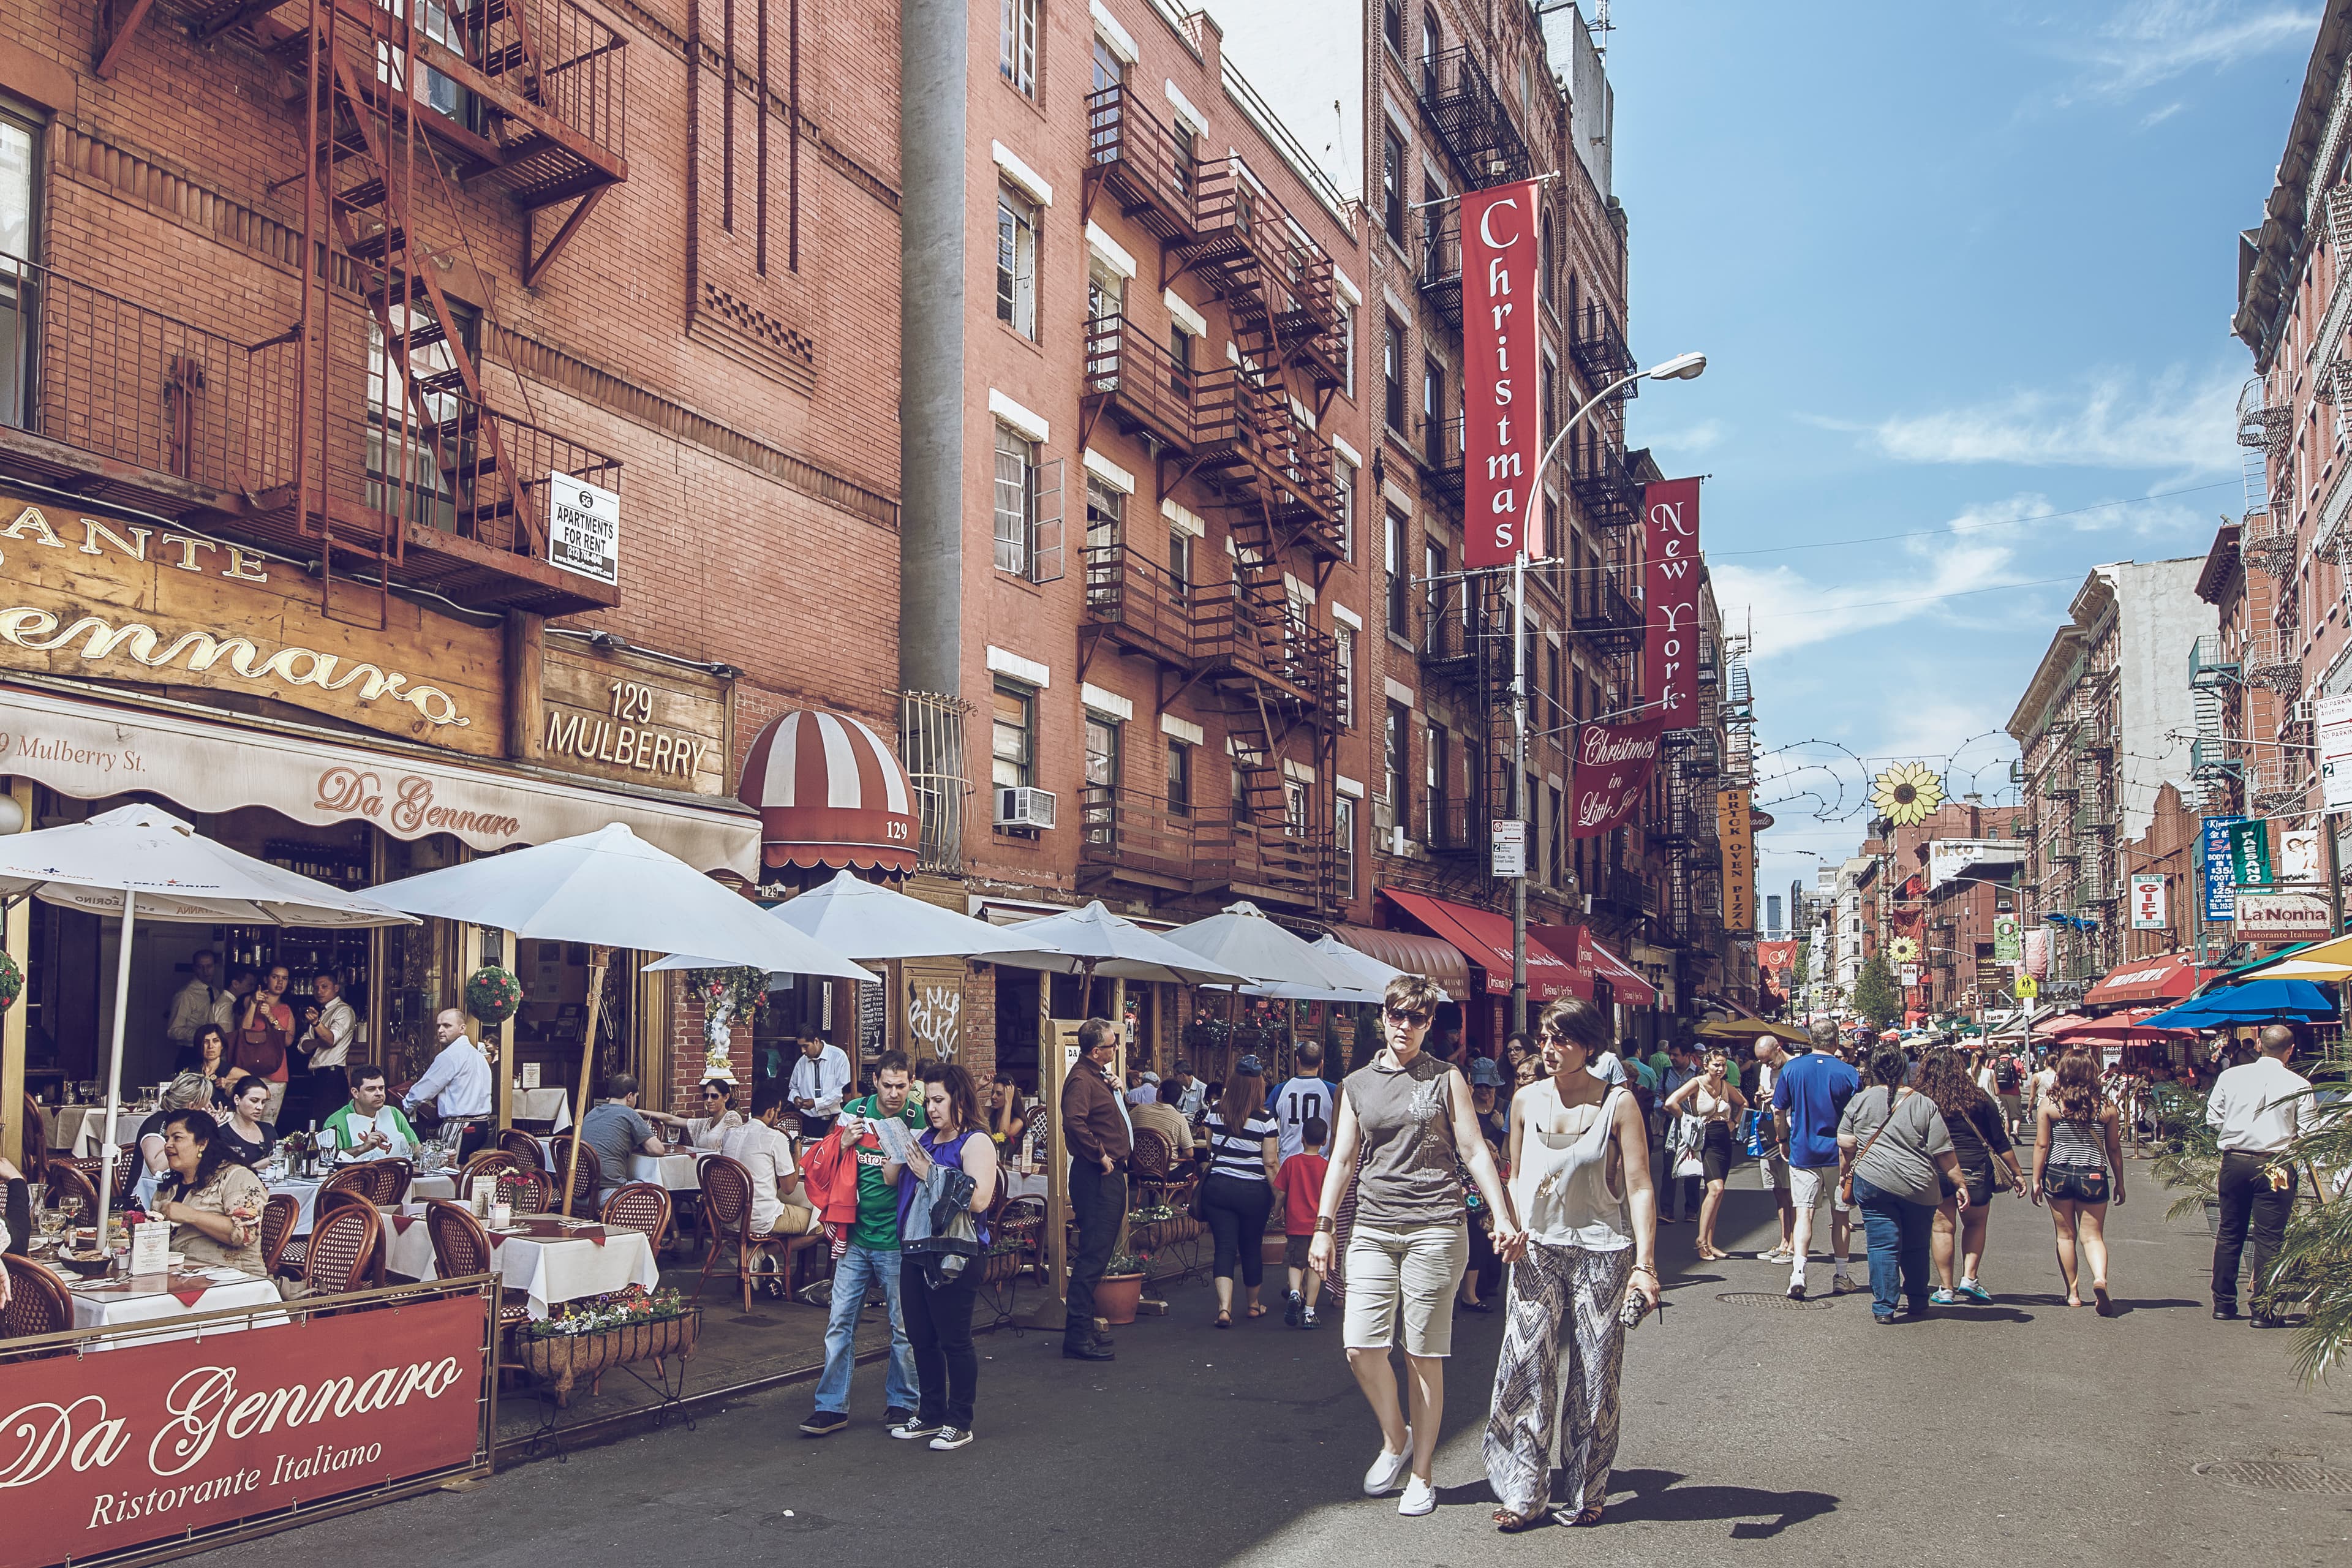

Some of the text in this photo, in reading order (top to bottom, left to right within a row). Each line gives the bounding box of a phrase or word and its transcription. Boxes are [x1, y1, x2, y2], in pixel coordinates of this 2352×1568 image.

[1480, 198, 1523, 548] Christmas
[557, 506, 613, 540] APARTMENTS
[564, 526, 606, 554] FOR RENT
[0, 507, 268, 583] ANTE
[567, 545, 580, 560] (212)
[1651, 501, 1695, 711] New York
[0, 605, 470, 727] ennaro
[611, 680, 653, 724] 129
[17, 734, 116, 772] Mulberry
[123, 750, 146, 772] St.
[546, 711, 707, 778] MULBERRY
[1584, 726, 1657, 765] Christmas
[1608, 772, 1623, 789] in
[2324, 764, 2333, 777] 2
[314, 766, 521, 837] Da Gennaro
[886, 820, 908, 840] 129
[1494, 843, 1499, 851] 2
[1728, 793, 1744, 927] BRICK OVEN PIZZA
[2241, 831, 2261, 882] PAESANO
[761, 886, 778, 898] 129
[2138, 884, 2158, 920] GIFT
[2242, 907, 2327, 921] La Nonna
[1126, 1021, 1132, 1034] A
[1288, 1092, 1321, 1125] 10
[0, 1355, 464, 1488] Da Gennaro
[86, 1441, 383, 1531] Ristorante Italiano
